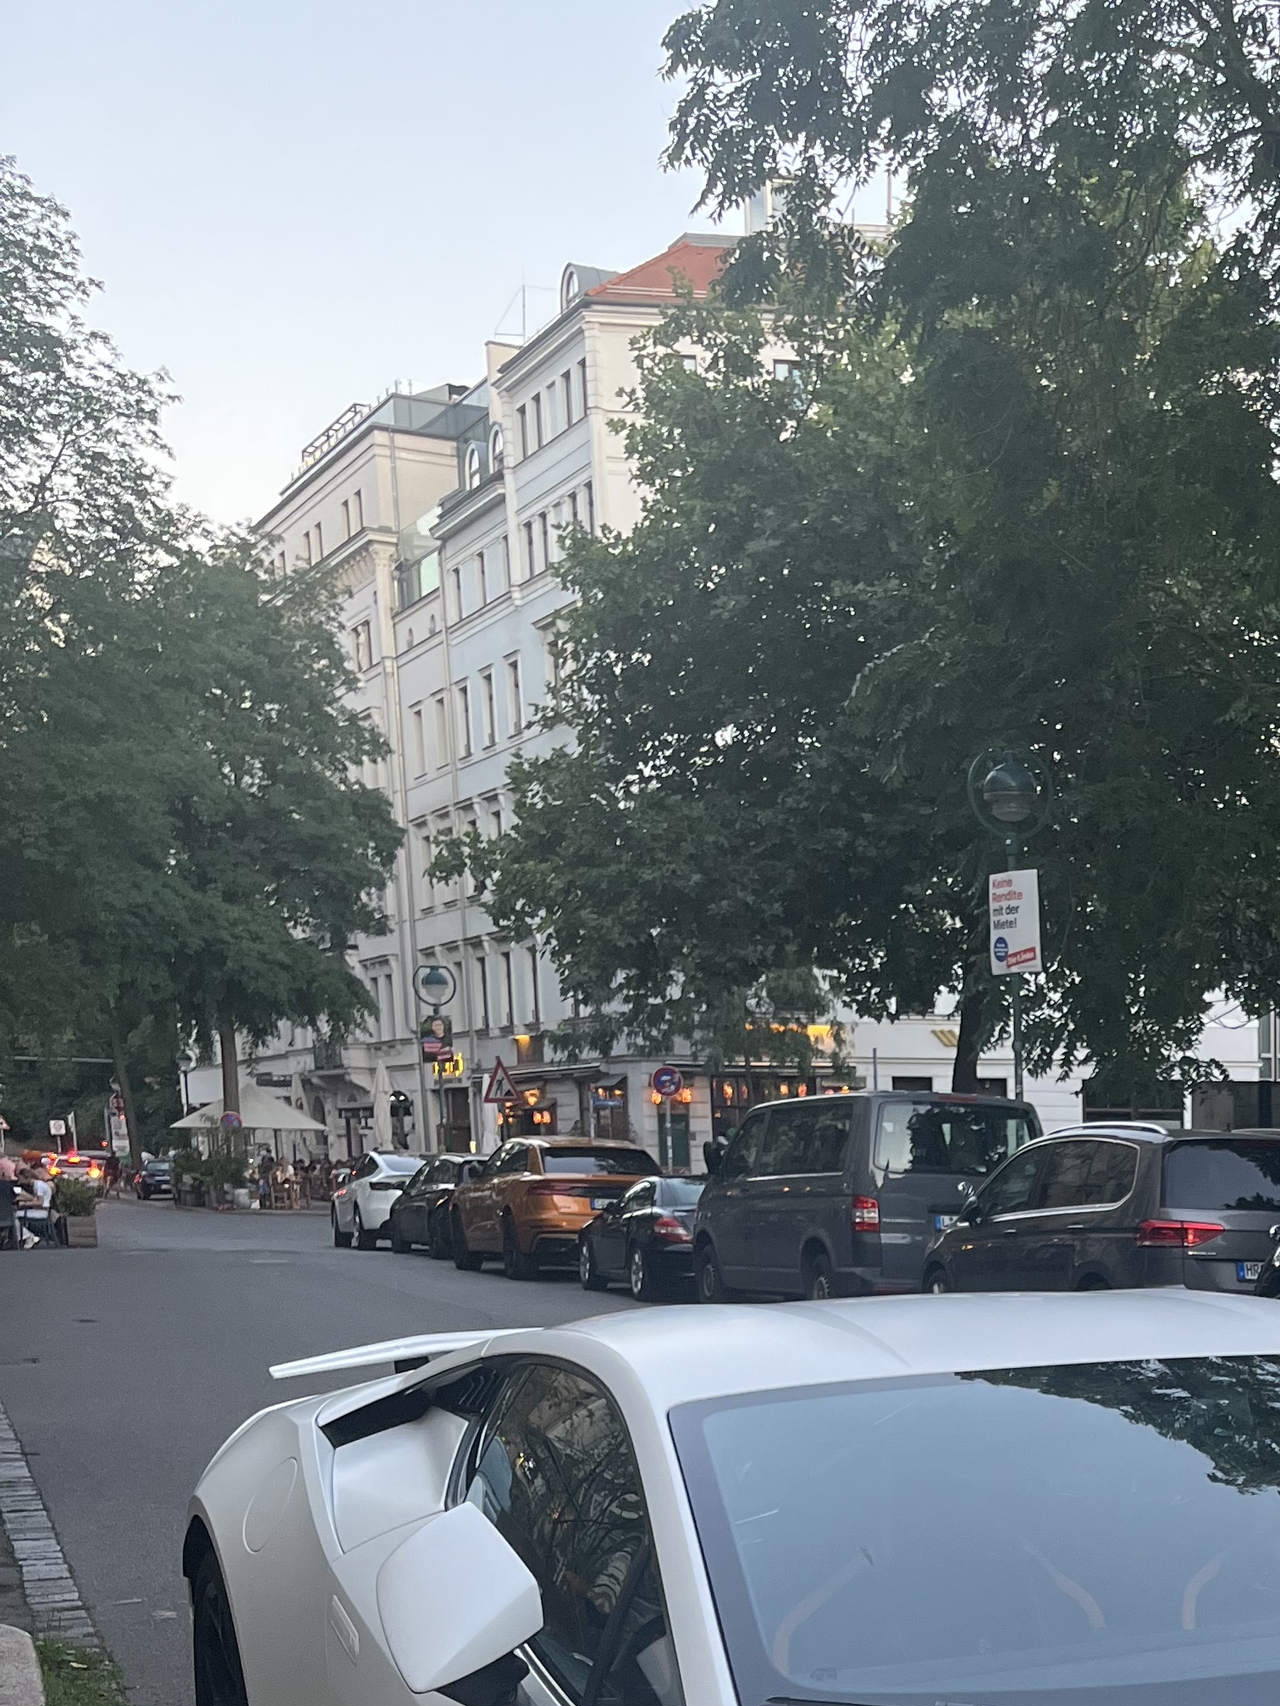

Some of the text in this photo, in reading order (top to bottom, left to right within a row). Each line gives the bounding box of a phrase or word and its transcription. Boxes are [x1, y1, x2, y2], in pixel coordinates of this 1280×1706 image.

[992, 878, 1013, 889] Keine
[992, 890, 1023, 903] Rendite
[1005, 904, 1020, 915] der
[993, 917, 1017, 930] Miete!
